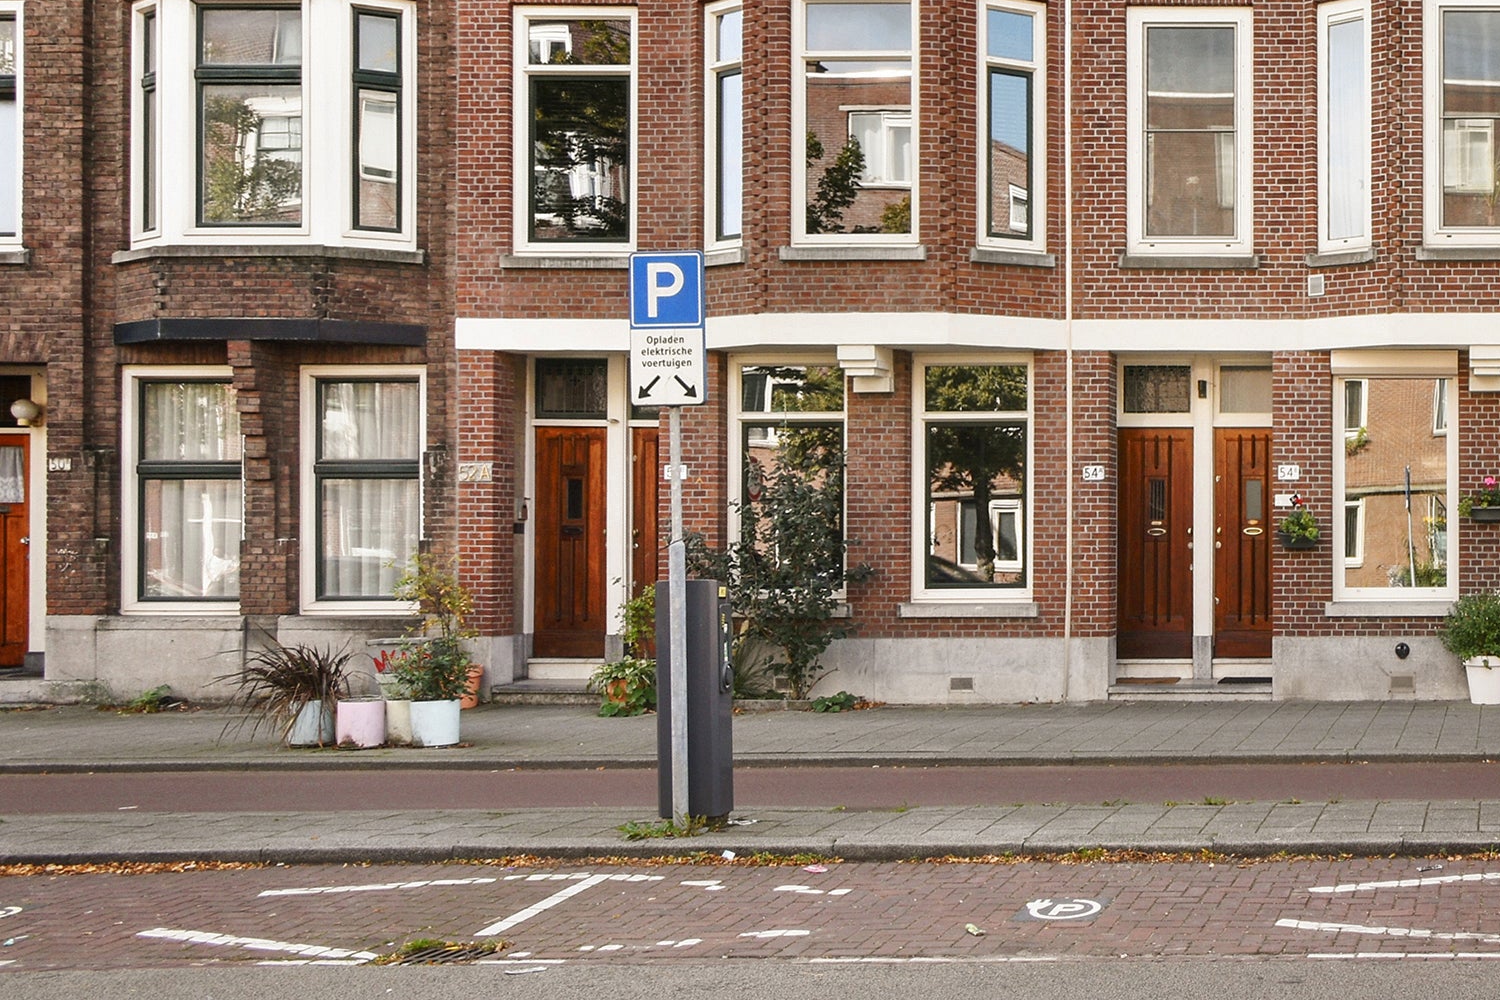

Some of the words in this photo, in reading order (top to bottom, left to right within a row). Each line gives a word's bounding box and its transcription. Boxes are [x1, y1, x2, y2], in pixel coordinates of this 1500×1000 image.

[647, 262, 685, 318] P
[646, 335, 685, 345] Opladen
[641, 346, 693, 356] elektrische
[641, 358, 693, 369] voertuigen
